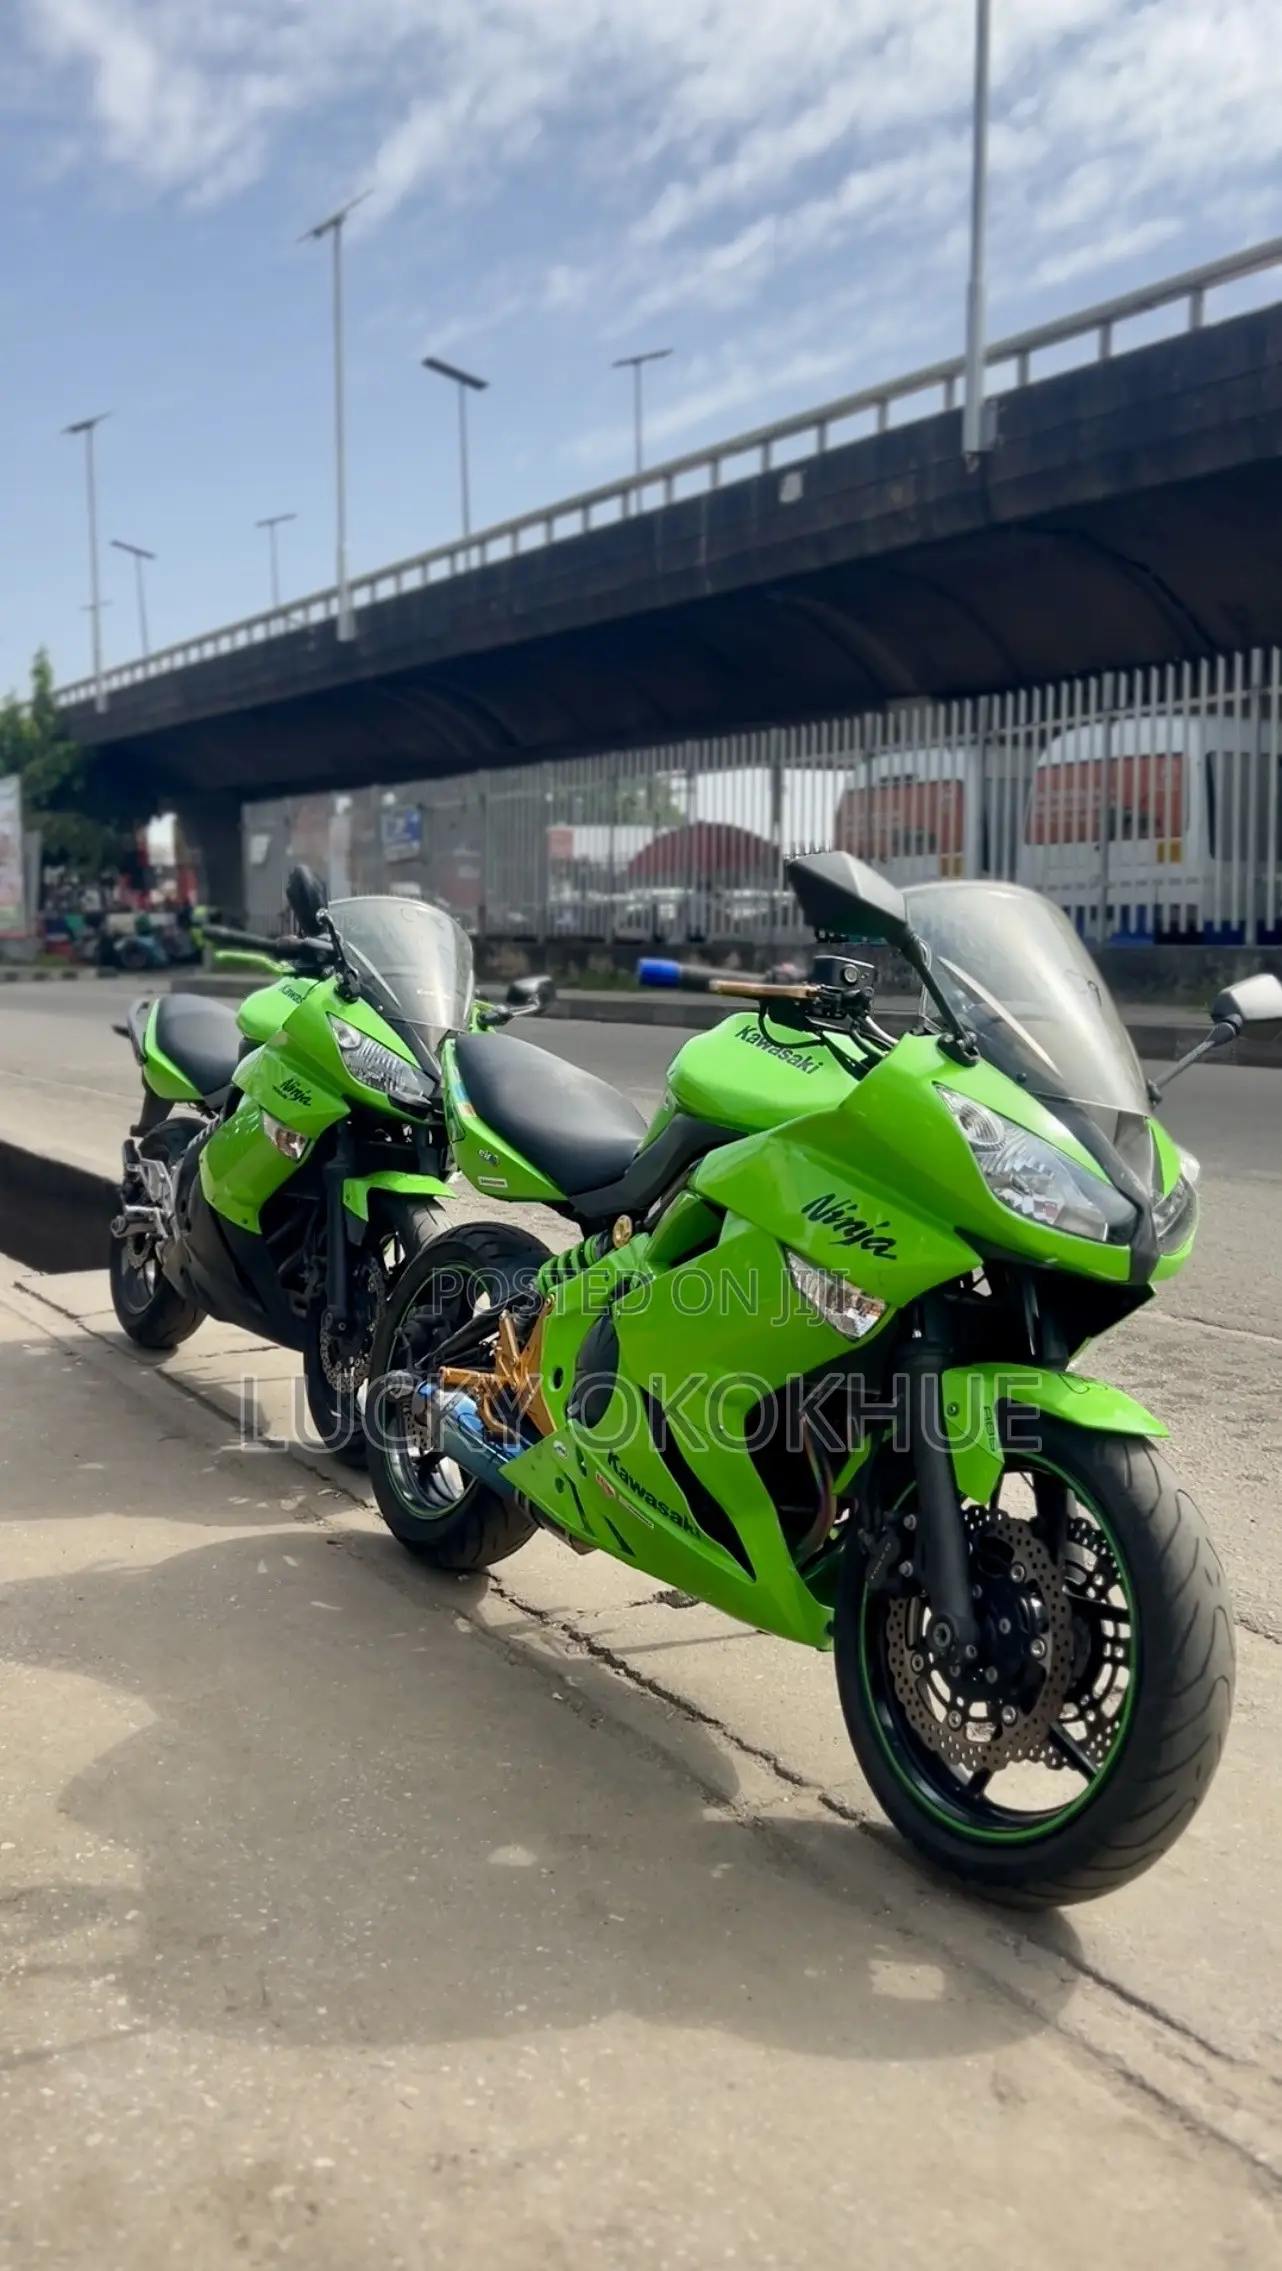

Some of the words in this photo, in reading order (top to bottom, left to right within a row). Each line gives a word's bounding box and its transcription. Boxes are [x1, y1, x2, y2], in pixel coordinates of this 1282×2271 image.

[735, 1024, 824, 1075] Kawasaki
[279, 1078, 312, 1107] Ninja
[801, 1193, 898, 1260] Ninja
[607, 1449, 702, 1541] Kawasaki
